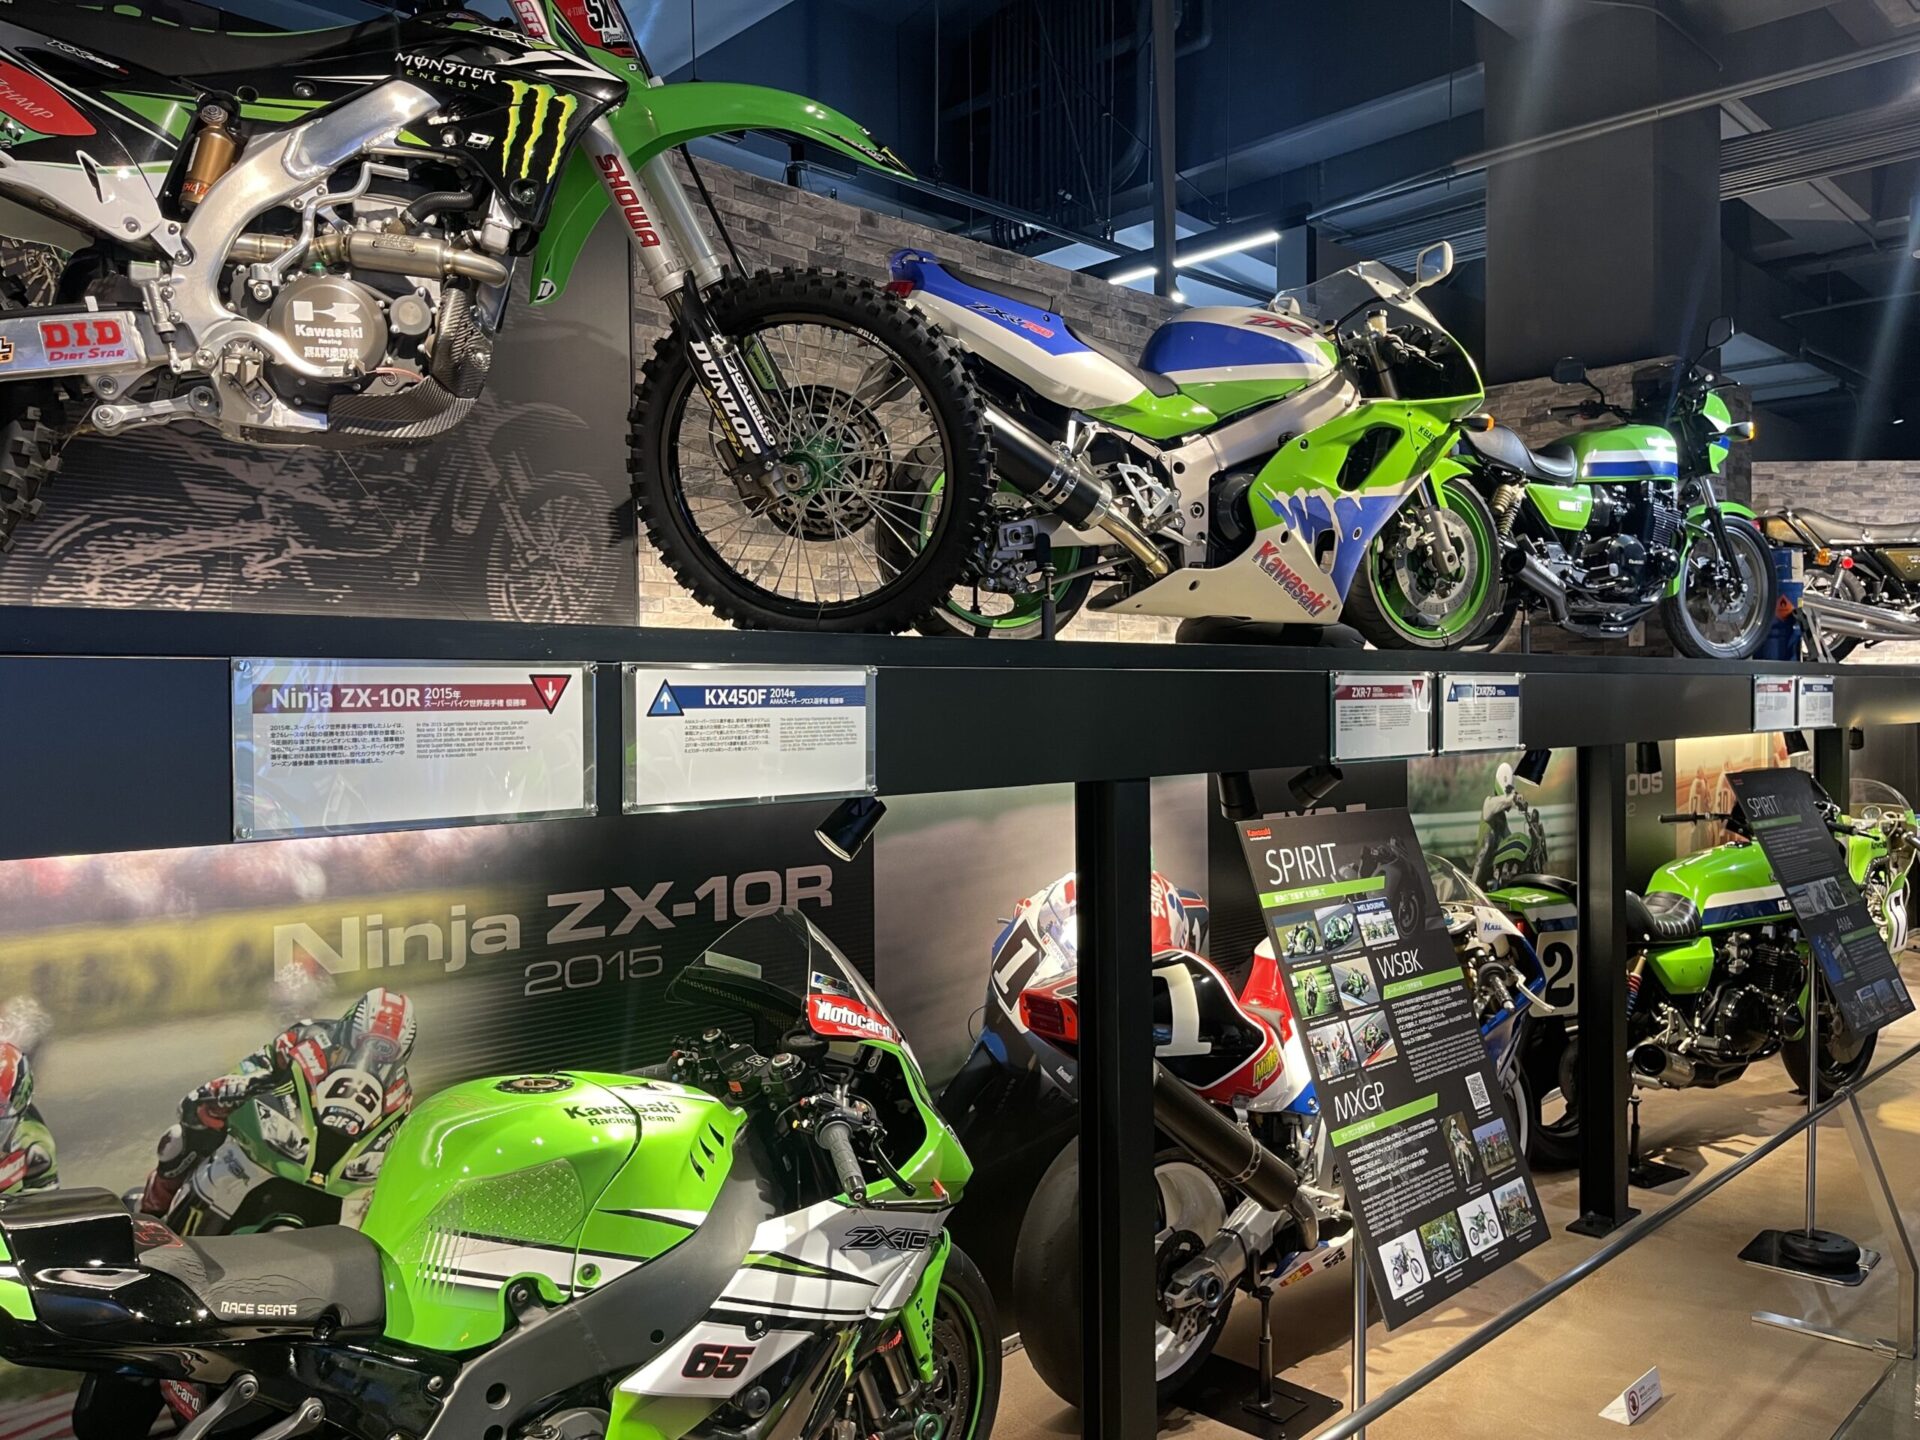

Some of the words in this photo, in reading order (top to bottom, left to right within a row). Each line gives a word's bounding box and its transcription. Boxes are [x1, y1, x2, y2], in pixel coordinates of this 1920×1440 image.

[394, 52, 497, 84] MONSTER
[406, 69, 479, 91] ENERGY
[596, 154, 660, 248] SHOWA
[295, 324, 363, 339] Kawasaki
[690, 341, 761, 455] DUNLOP
[1252, 540, 1331, 616] Kawasaki
[271, 688, 333, 712] Ninja
[340, 689, 420, 708] ZX-10R
[424, 687, 460, 699] 2015年
[705, 689, 766, 705] KX450F
[1747, 796, 1780, 817] SPIRIT
[1266, 843, 1338, 885] SPIRIT
[546, 864, 833, 945] ZX-10R
[274, 905, 521, 983] Ninja
[524, 946, 664, 996] 2015
[1377, 949, 1424, 980] WSBK
[1544, 942, 1574, 1008] 2
[323, 1078, 380, 1113] 65
[563, 1100, 681, 1120] Kawasaki
[1334, 1081, 1385, 1122] MXGP
[588, 1113, 634, 1127] Racing
[642, 1113, 675, 1125] Team
[220, 1301, 255, 1314] RACE
[257, 1303, 297, 1316] SEATS
[681, 1344, 756, 1379] 65
